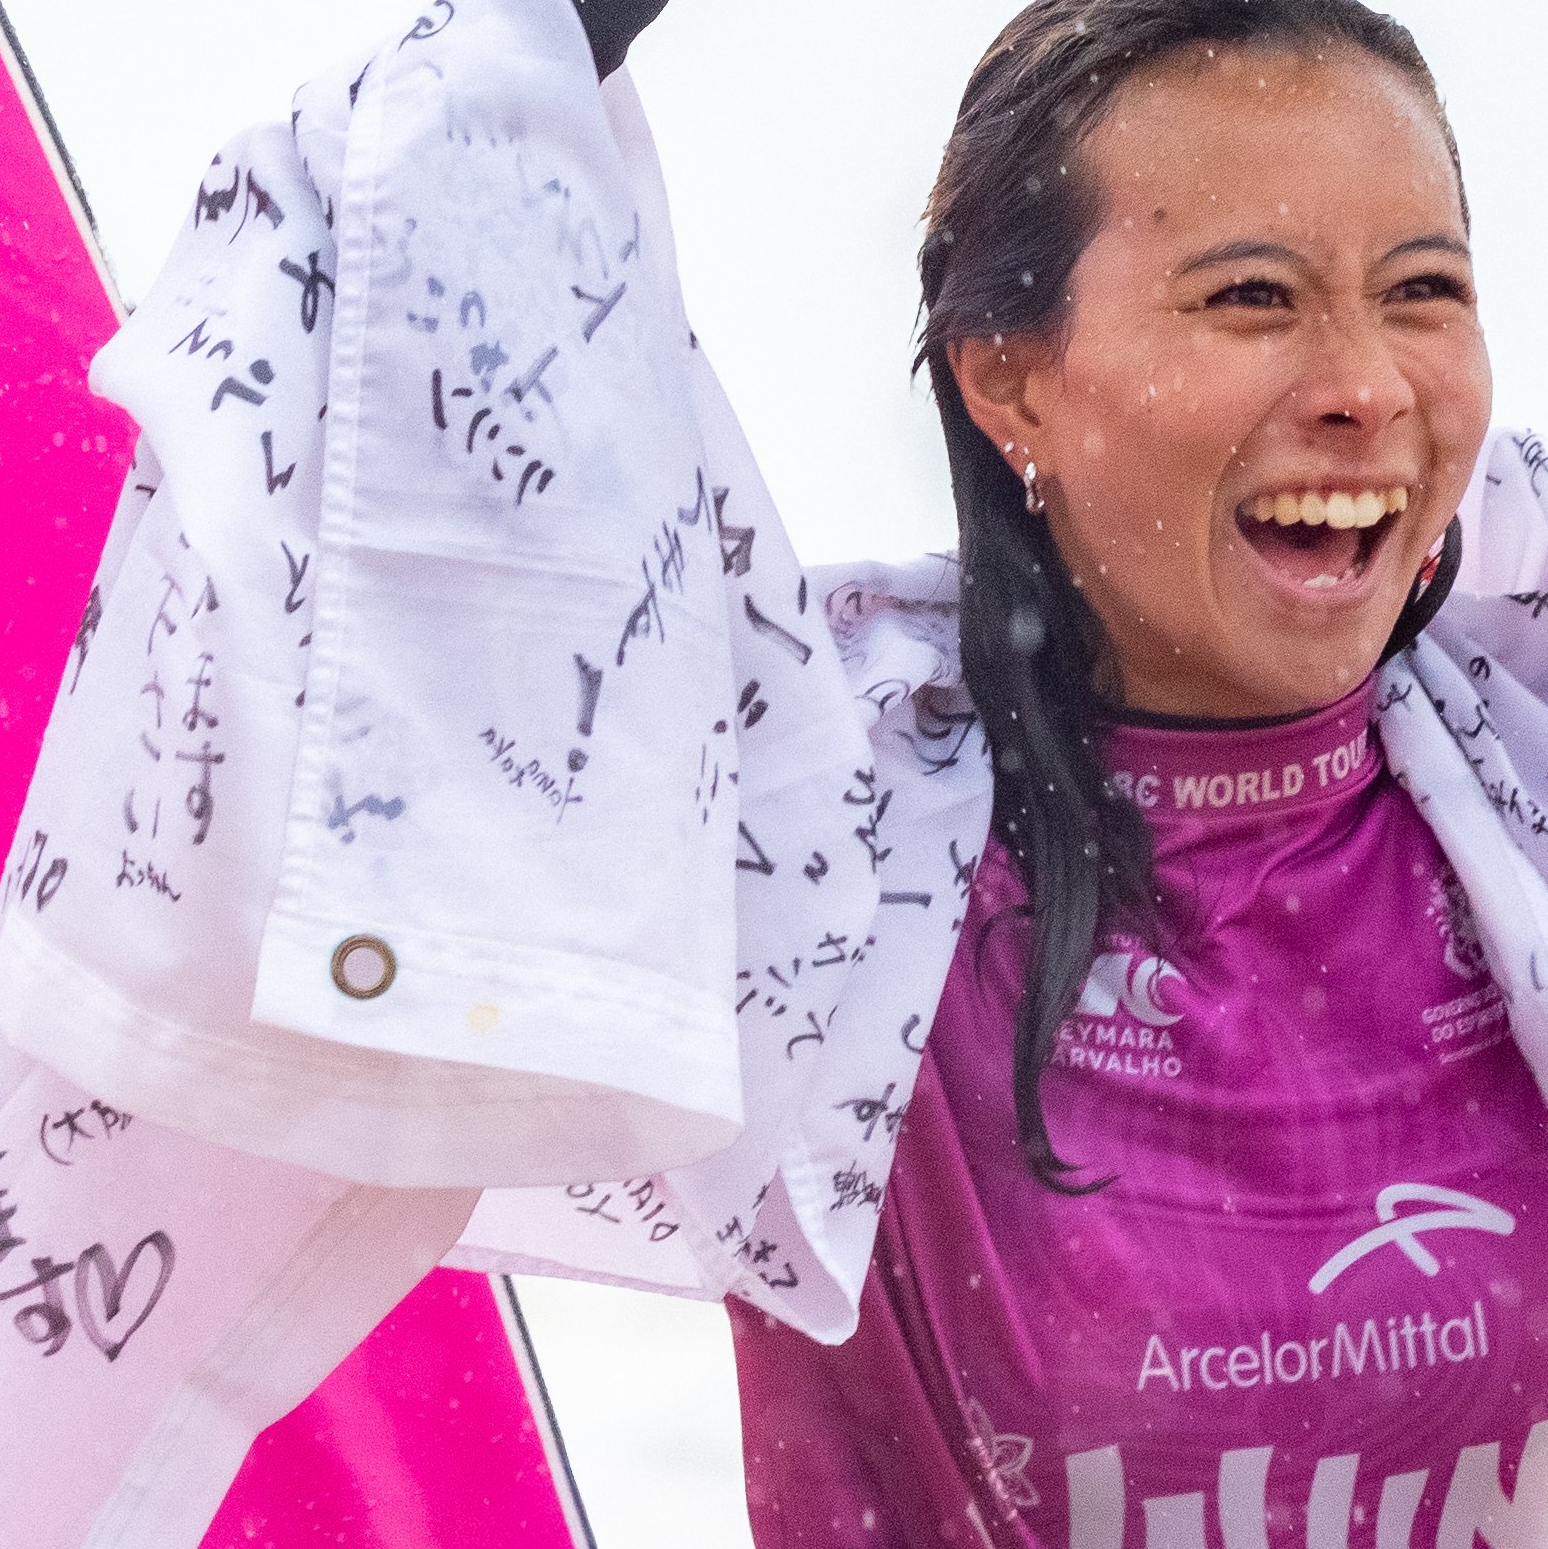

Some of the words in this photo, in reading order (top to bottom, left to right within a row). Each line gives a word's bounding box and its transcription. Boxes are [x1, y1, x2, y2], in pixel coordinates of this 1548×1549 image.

[1172, 763, 1304, 809] WORLD
[1312, 728, 1368, 787] TOU
[1052, 1046, 1183, 1078] ARVALHO
[1057, 1020, 1174, 1051] EYMARA
[1137, 1301, 1490, 1391] ArcelorMittal
